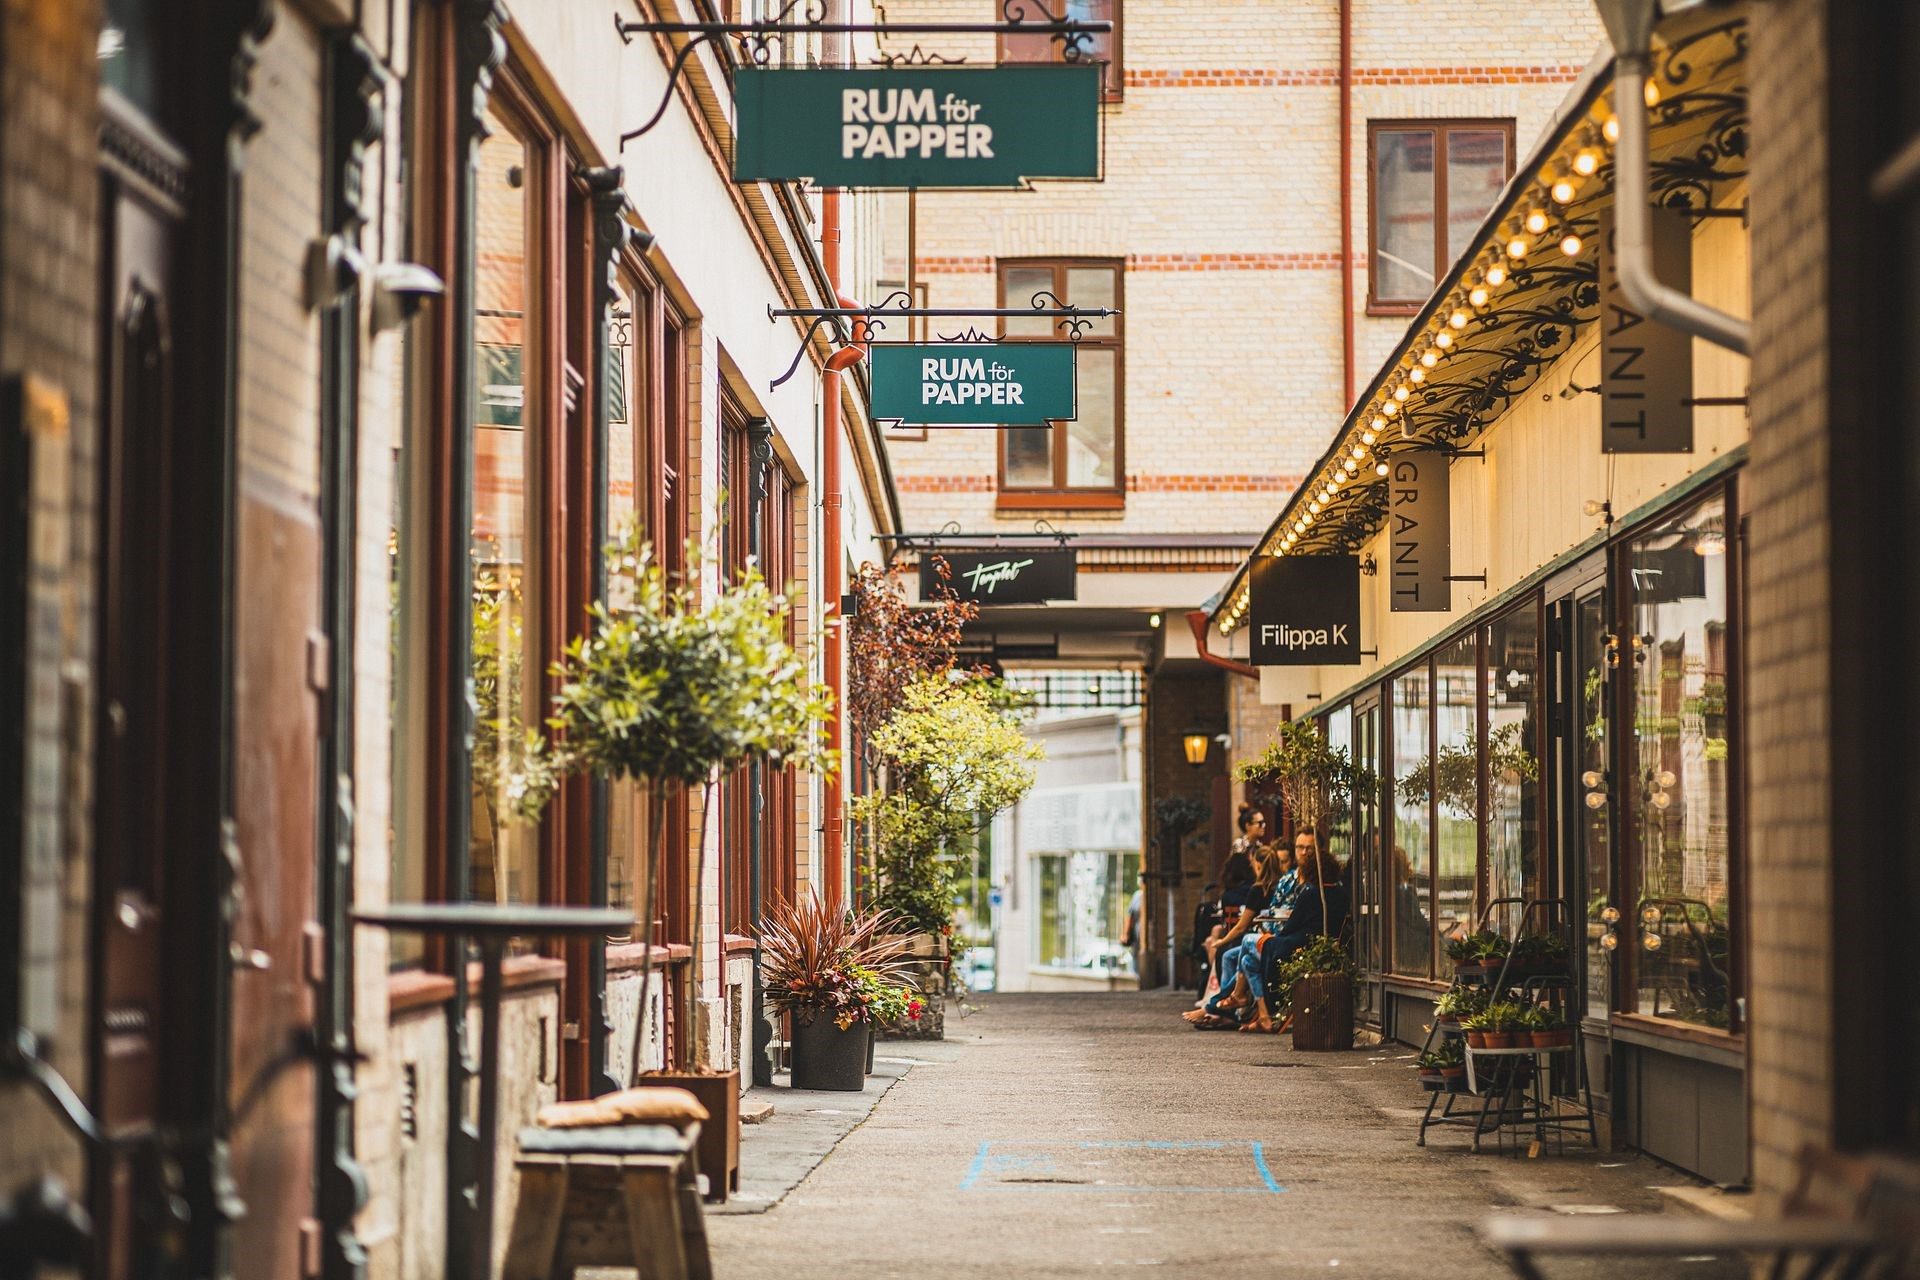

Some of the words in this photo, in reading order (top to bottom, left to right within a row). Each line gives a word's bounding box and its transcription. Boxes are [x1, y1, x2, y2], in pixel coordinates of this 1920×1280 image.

[842, 88, 934, 123] RUM
[940, 92, 980, 123] för
[842, 124, 994, 159] PAPPER
[1608, 228, 1646, 439] ANIT
[922, 358, 985, 380] RUM
[988, 361, 1015, 381] för
[922, 383, 1024, 405] PAPPER
[1395, 461, 1419, 602] GRANIT
[1261, 624, 1328, 651] Filippa
[1333, 624, 1348, 645] K
